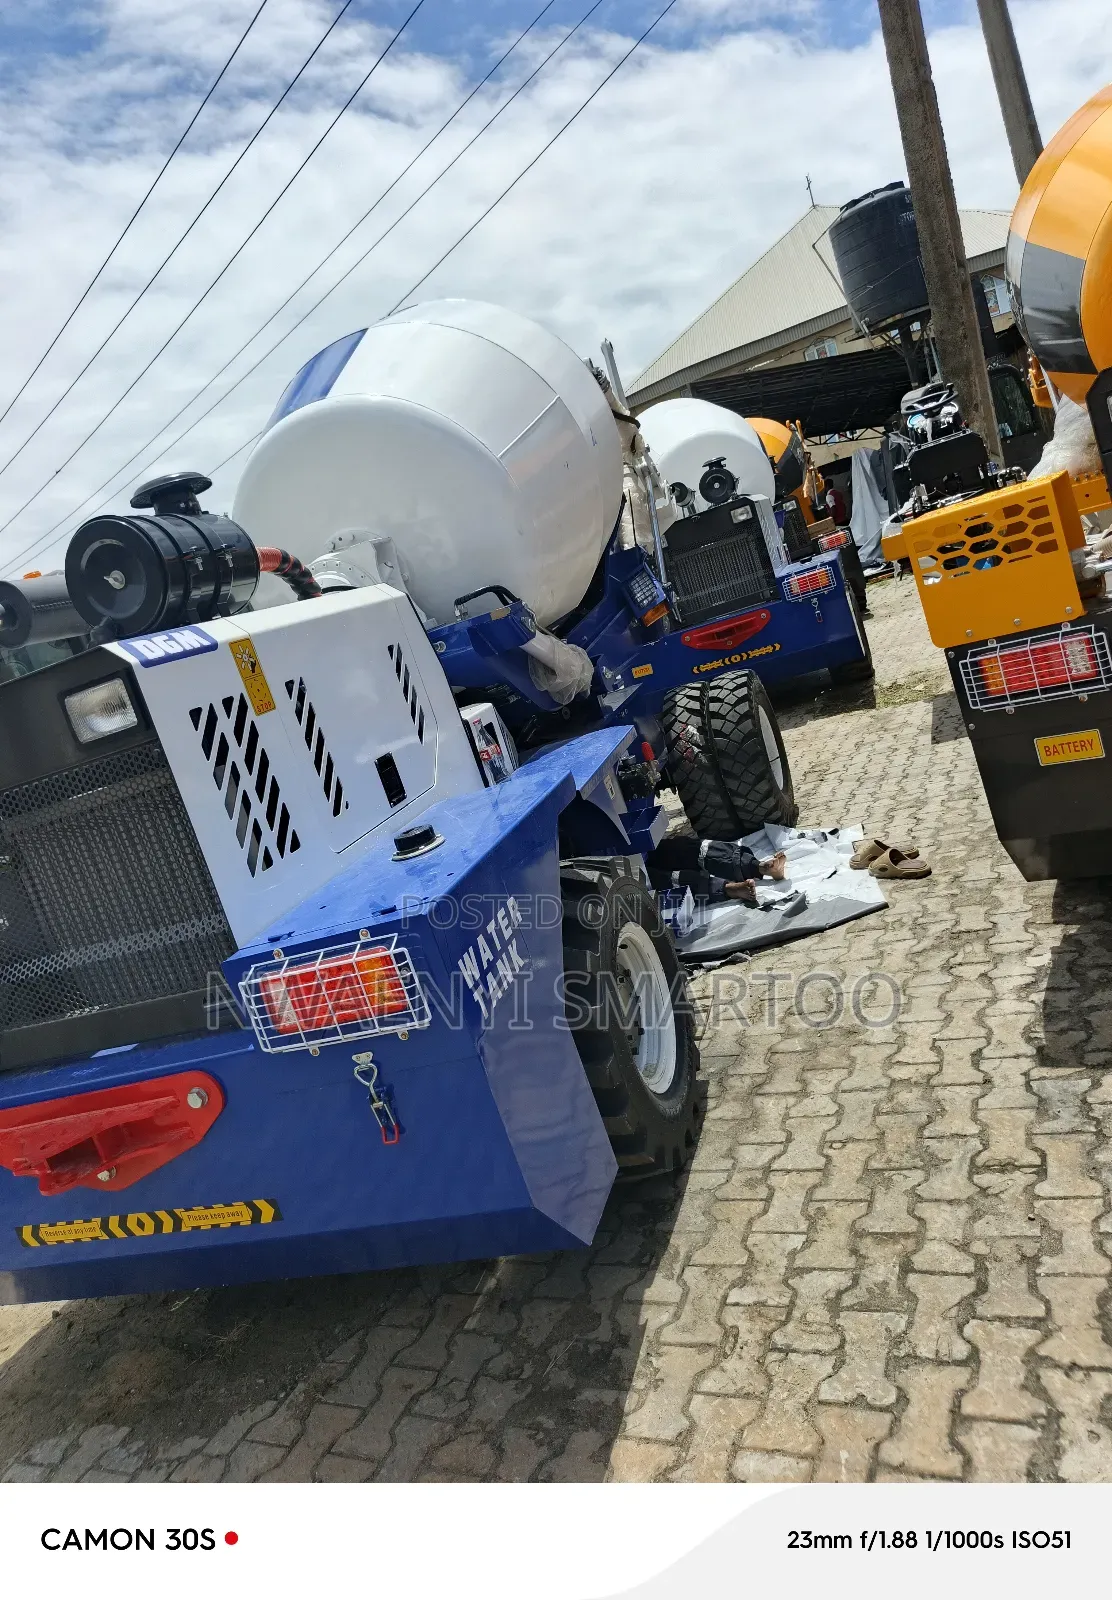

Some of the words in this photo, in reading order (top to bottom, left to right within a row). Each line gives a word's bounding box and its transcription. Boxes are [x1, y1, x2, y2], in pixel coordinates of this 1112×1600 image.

[128, 629, 212, 660] DGM
[256, 701, 272, 713] STOP
[1043, 739, 1094, 757] BATTERY
[458, 896, 522, 989] WATER
[473, 938, 525, 1019] TANK
[186, 1213, 210, 1222] Please
[226, 1209, 244, 1219] away
[44, 1229, 67, 1238] Reverse
